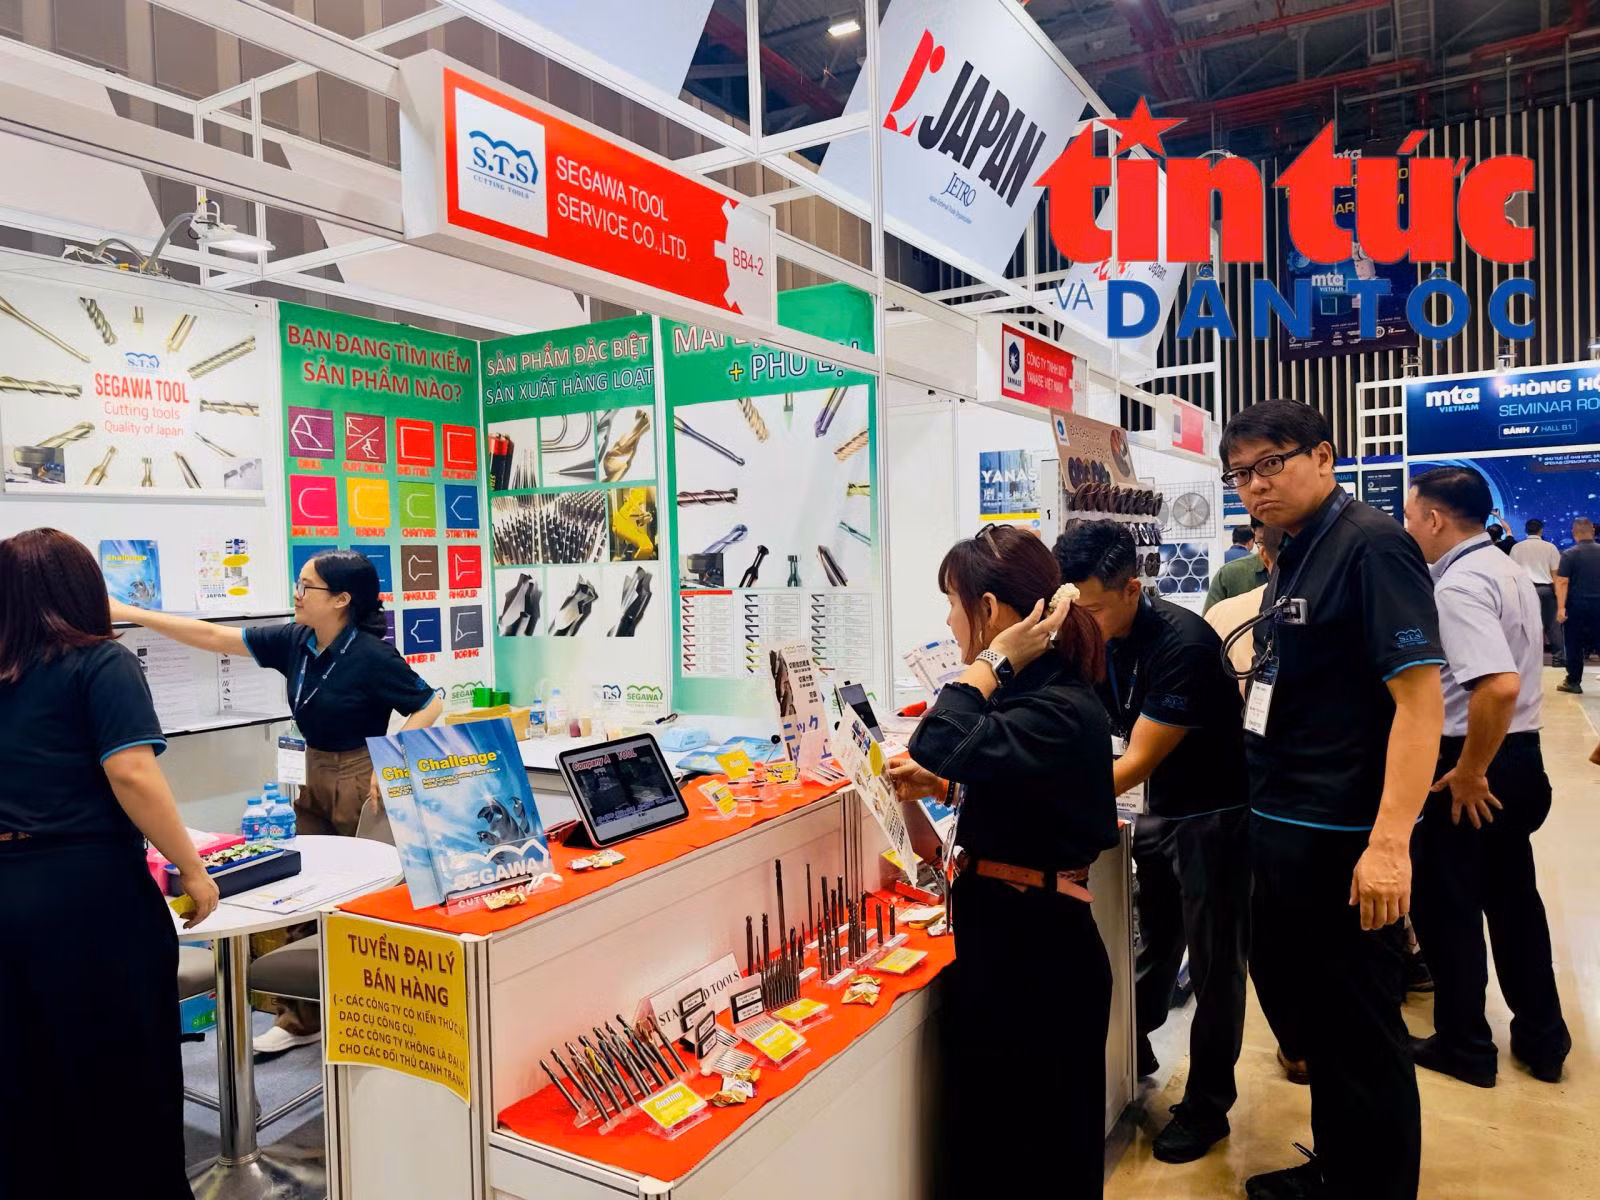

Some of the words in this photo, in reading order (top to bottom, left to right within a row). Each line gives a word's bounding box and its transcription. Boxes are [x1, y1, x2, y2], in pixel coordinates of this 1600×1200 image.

[918, 60, 1047, 208] JAPAN
[473, 174, 505, 191] CUTTING
[507, 185, 530, 199] TOOLS
[556, 155, 627, 205] SEGAWA
[629, 185, 669, 222] TOOL
[940, 171, 976, 207] JETRO
[557, 192, 628, 239] SERVICE
[733, 247, 764, 277] BB4-2
[288, 325, 331, 351] BẠN
[335, 334, 391, 360] ĐANG
[394, 341, 427, 367] TÌM
[431, 347, 471, 374] KIẾM
[487, 352, 517, 376] SẢN
[521, 343, 570, 370] PHẨM
[574, 339, 608, 367] ĐẶC
[613, 333, 649, 359] BIỆT
[95, 373, 153, 400] SEGAWA
[155, 380, 190, 403] TOOL
[304, 357, 345, 385] SẢN
[352, 366, 409, 395] PHẨM
[415, 376, 462, 402] NÀO?
[486, 380, 515, 405] SẢN
[519, 374, 557, 400] XUẤT
[562, 373, 608, 396] HÀNG
[613, 367, 655, 391] LOẠT
[1499, 379, 1572, 398] PHÒNG
[104, 401, 148, 420] Cutting
[152, 407, 181, 420] tools
[1425, 385, 1480, 408] mta
[1440, 404, 1479, 414] VIETNAM
[1499, 400, 1571, 417] SEMINAR
[105, 420, 141, 436] Quality
[144, 423, 155, 434] of
[156, 425, 184, 438] Japan
[1541, 425, 1560, 433] HALL
[627, 693, 659, 701] SEGAWA
[417, 751, 498, 772] Challenge
[572, 757, 604, 772] Company
[617, 748, 638, 761] TOOL
[453, 858, 538, 891] SEGAWA
[347, 933, 399, 962] TUYỂN
[404, 946, 433, 974] ĐẠI
[438, 951, 455, 977] LÝ
[363, 967, 396, 994] BÁN
[401, 975, 449, 1008] HÀNG
[710, 970, 740, 996] TOOLS
[339, 1010, 360, 1022] DAO
[363, 1013, 374, 1025] CỤ
[377, 1015, 400, 1031] CÔNG
[402, 1023, 416, 1036] CỤ.
[346, 994, 364, 1007] CÁC
[366, 998, 389, 1012] CÔNG
[392, 1004, 401, 1015] TY
[403, 1007, 414, 1019] CÓ
[416, 1010, 436, 1024] KIẾN
[438, 1016, 459, 1034] THỨC
[339, 1043, 360, 1055] CHO
[363, 1045, 380, 1058] CÁC
[383, 1048, 398, 1062] ĐỐI
[400, 1054, 416, 1068] THỦ
[419, 1060, 442, 1077] CẠNH
[346, 1027, 364, 1039] CÁC
[366, 1029, 391, 1044] CÔNG
[393, 1036, 402, 1047] TY
[404, 1039, 435, 1057] KHÔNG
[438, 1047, 447, 1060] LÀ
[448, 1053, 459, 1068] ĐẠI
